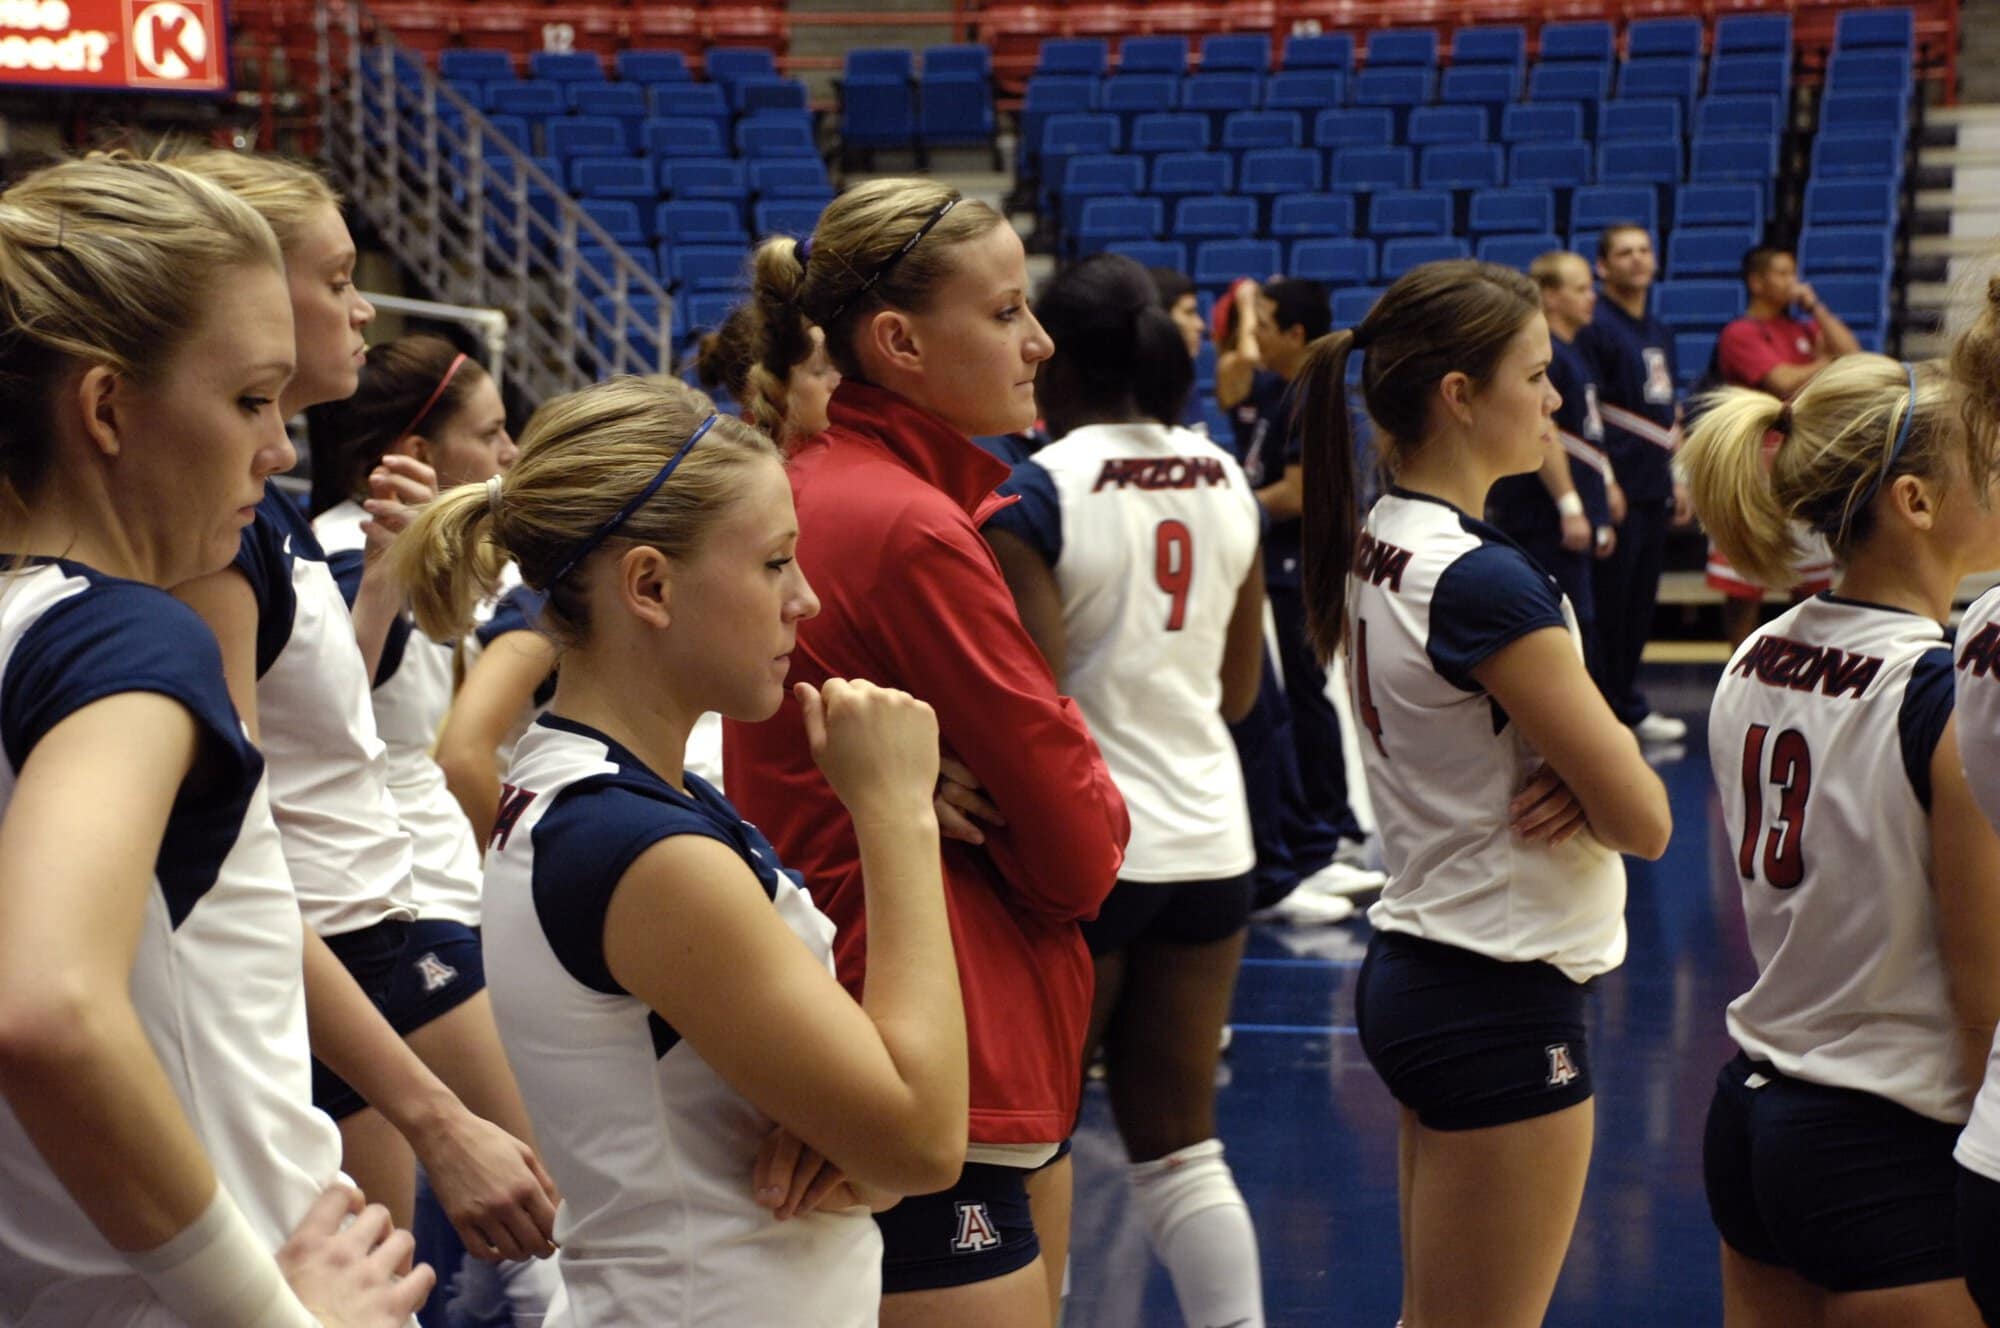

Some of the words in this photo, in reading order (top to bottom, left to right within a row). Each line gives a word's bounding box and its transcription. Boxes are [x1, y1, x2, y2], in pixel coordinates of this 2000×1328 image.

[1091, 456, 1231, 494] ARIZONA
[1155, 518, 1194, 632] 9
[1730, 635, 1884, 699] ARIZONA
[1740, 723, 1811, 889] 13
[1545, 1043, 1579, 1087] A
[952, 1201, 1001, 1254] A
